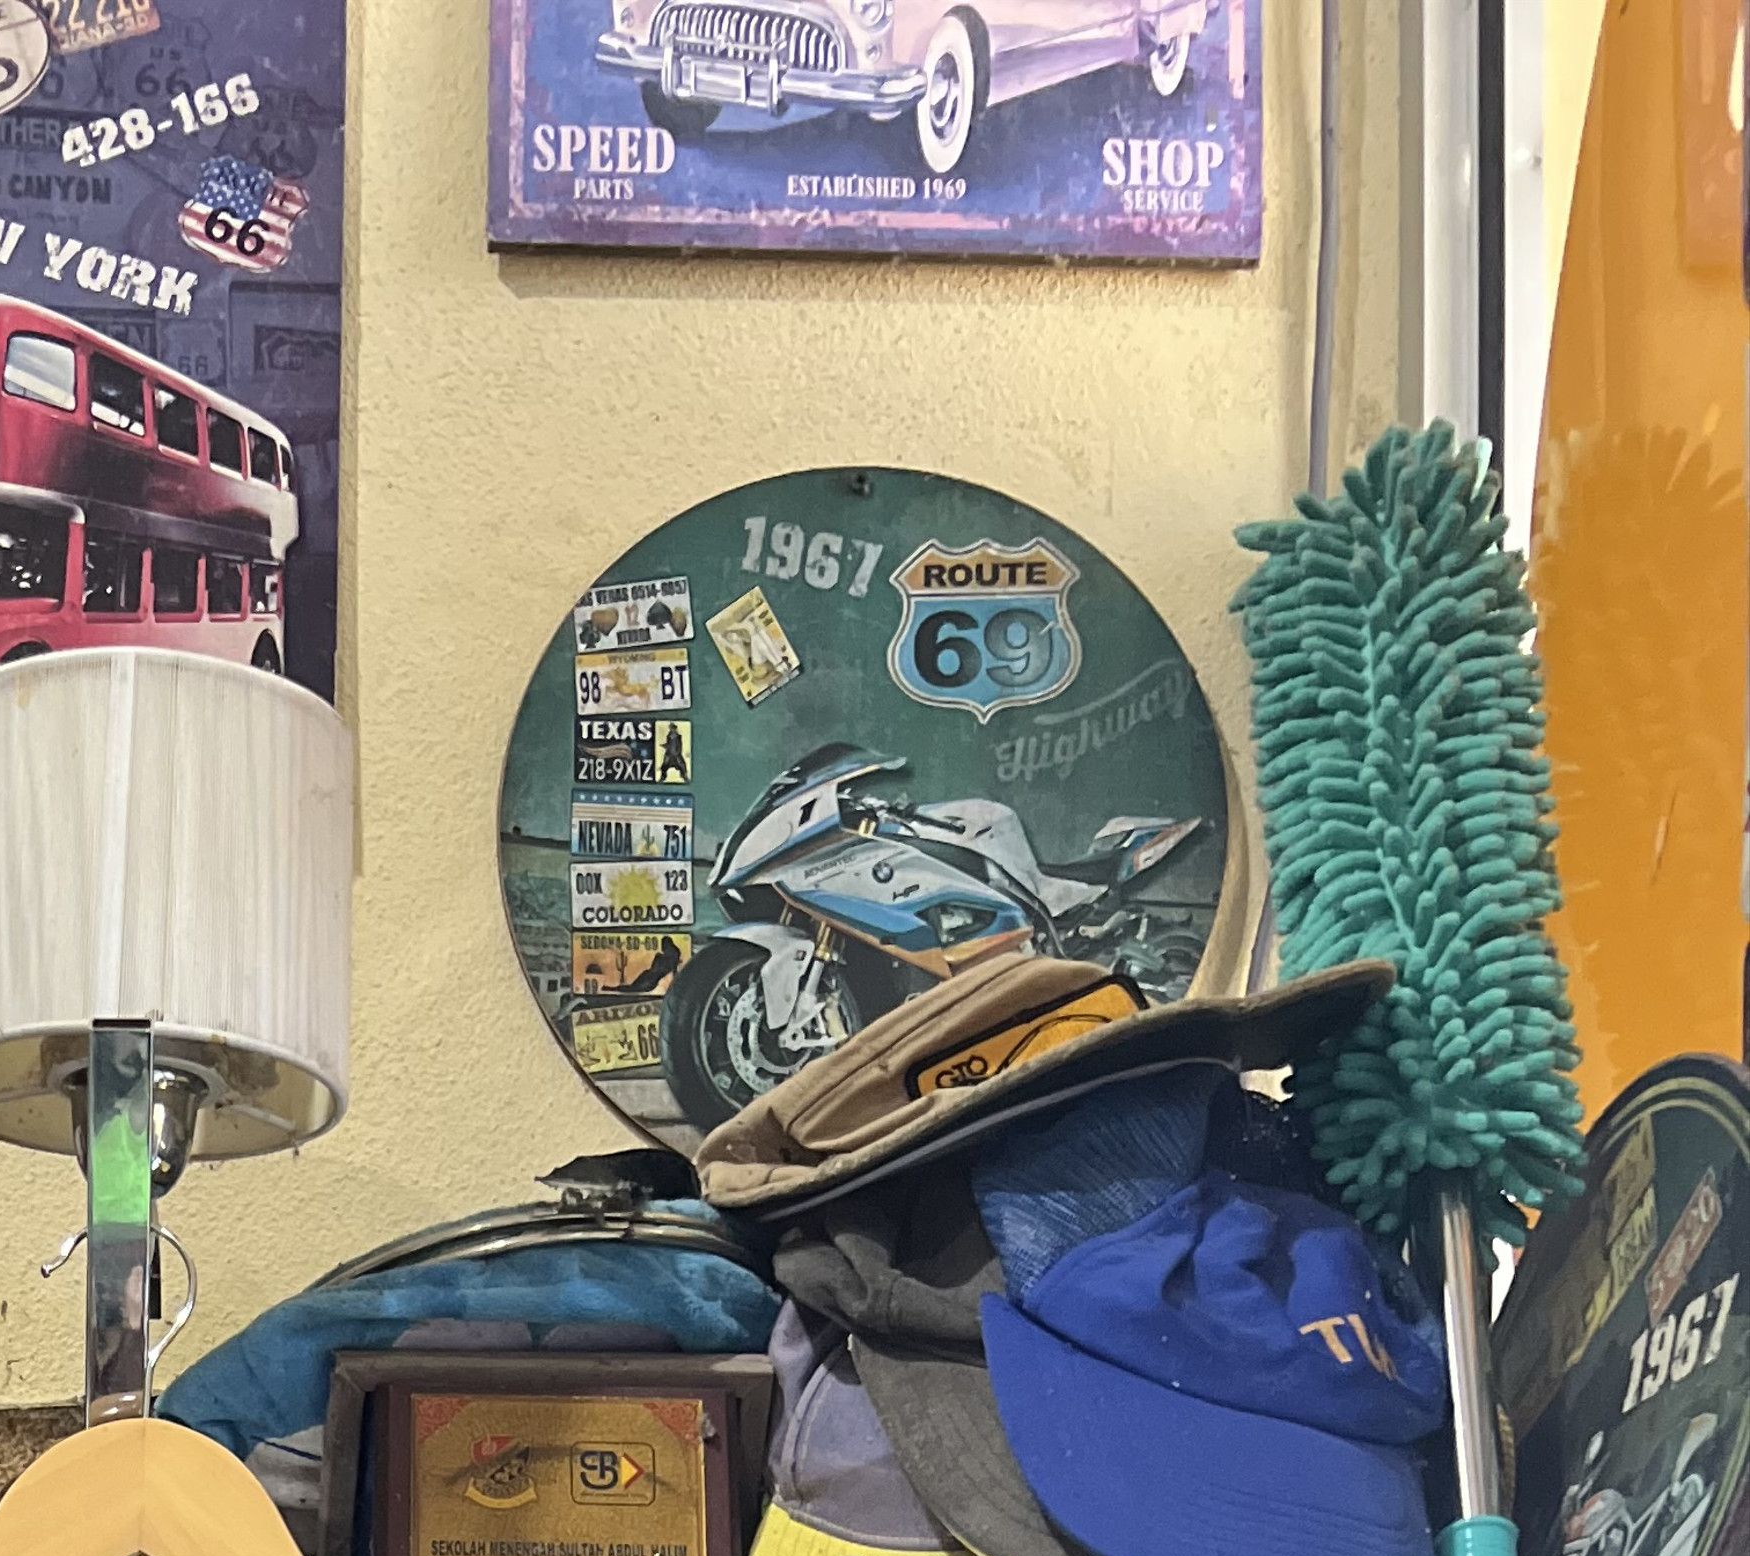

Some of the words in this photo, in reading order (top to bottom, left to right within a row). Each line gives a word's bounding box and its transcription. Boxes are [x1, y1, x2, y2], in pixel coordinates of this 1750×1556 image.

[61, 73, 260, 168] 428-166
[533, 124, 676, 174] SPEED
[1102, 138, 1225, 188] SHOP
[573, 177, 635, 200] PARTS
[787, 174, 917, 199] ESTABLISHED
[922, 177, 967, 201] 1969
[1123, 189, 1204, 213] SERVICE
[205, 206, 270, 257] 66
[43, 233, 199, 316] YORK
[740, 516, 884, 598] 1967
[924, 561, 1048, 588] ROUTE
[914, 608, 1053, 688] 69
[579, 671, 601, 704] 98
[661, 664, 688, 700] BT
[580, 720, 654, 741] TEXAS
[578, 819, 633, 856] NEVADA
[582, 903, 684, 923] COLORADO
[1621, 1272, 1740, 1414] 1967
[431, 1539, 486, 1556] SEKOLAH
